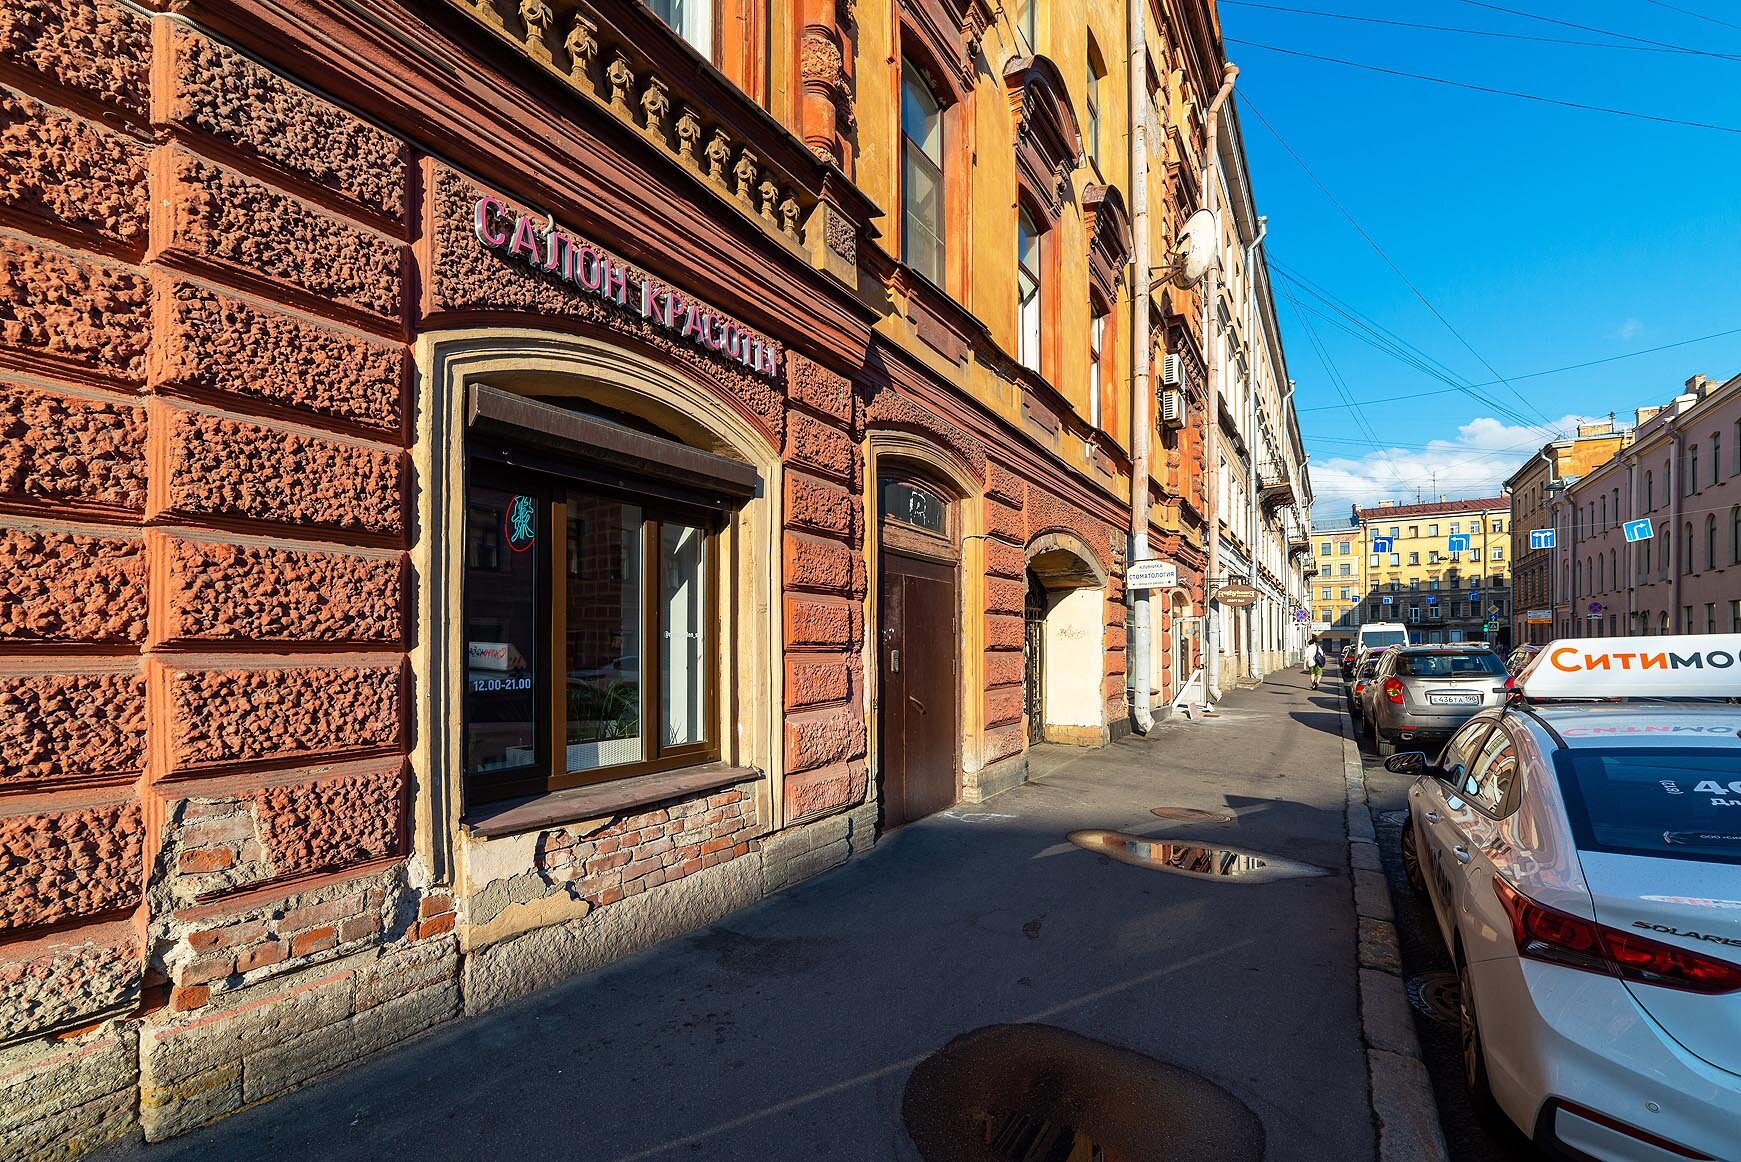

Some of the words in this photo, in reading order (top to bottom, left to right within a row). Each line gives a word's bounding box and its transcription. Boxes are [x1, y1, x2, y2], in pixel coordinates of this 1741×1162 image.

[474, 196, 627, 307] САЛОН
[641, 280, 778, 378] КРАСОТЫ
[1128, 571, 1175, 581] СТОМАТОЛОГИЯ
[1550, 647, 1741, 672] Ситимо
[473, 678, 531, 691] 12.00-21.00
[1659, 779, 1684, 795] (812)
